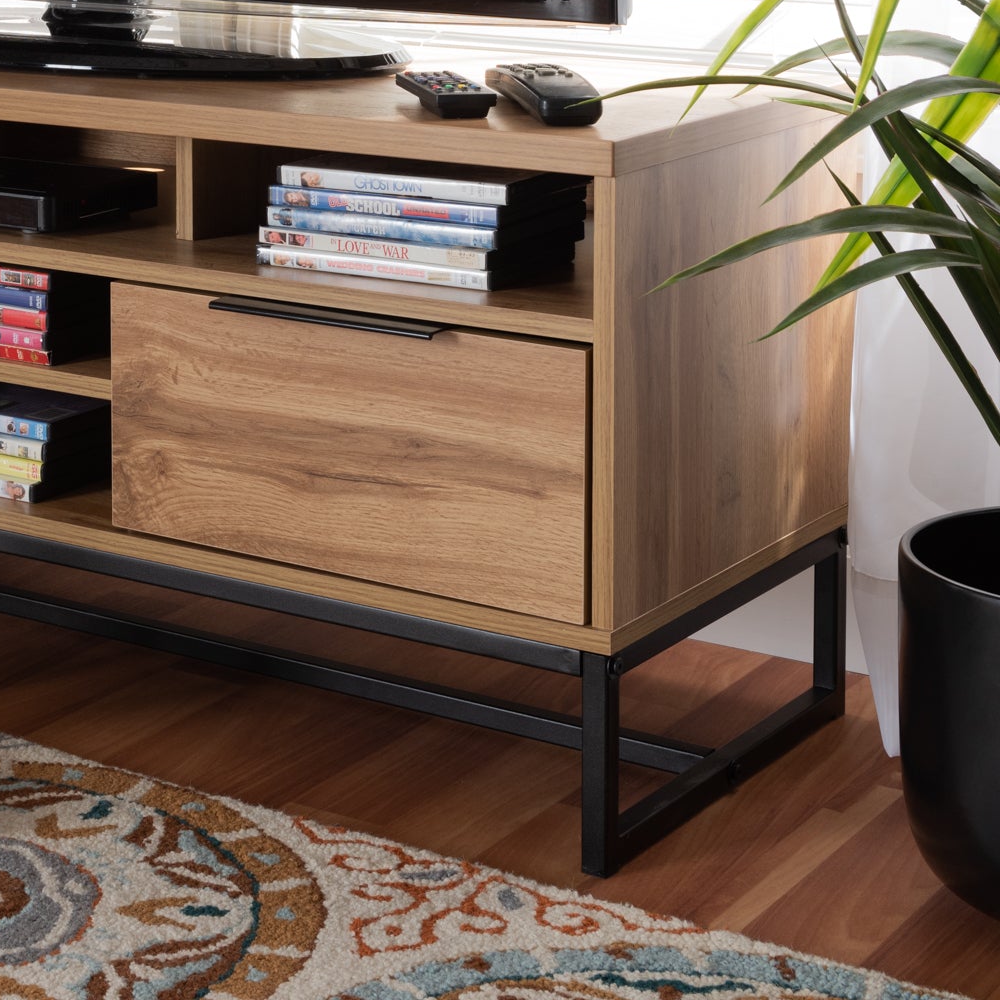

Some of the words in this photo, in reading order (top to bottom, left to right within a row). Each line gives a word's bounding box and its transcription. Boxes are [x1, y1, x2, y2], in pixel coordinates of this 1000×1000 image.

[354, 175, 390, 192] GHOST
[346, 199, 400, 216] SCHOOL
[337, 240, 370, 255] LOVE
[382, 244, 409, 259] WAR
